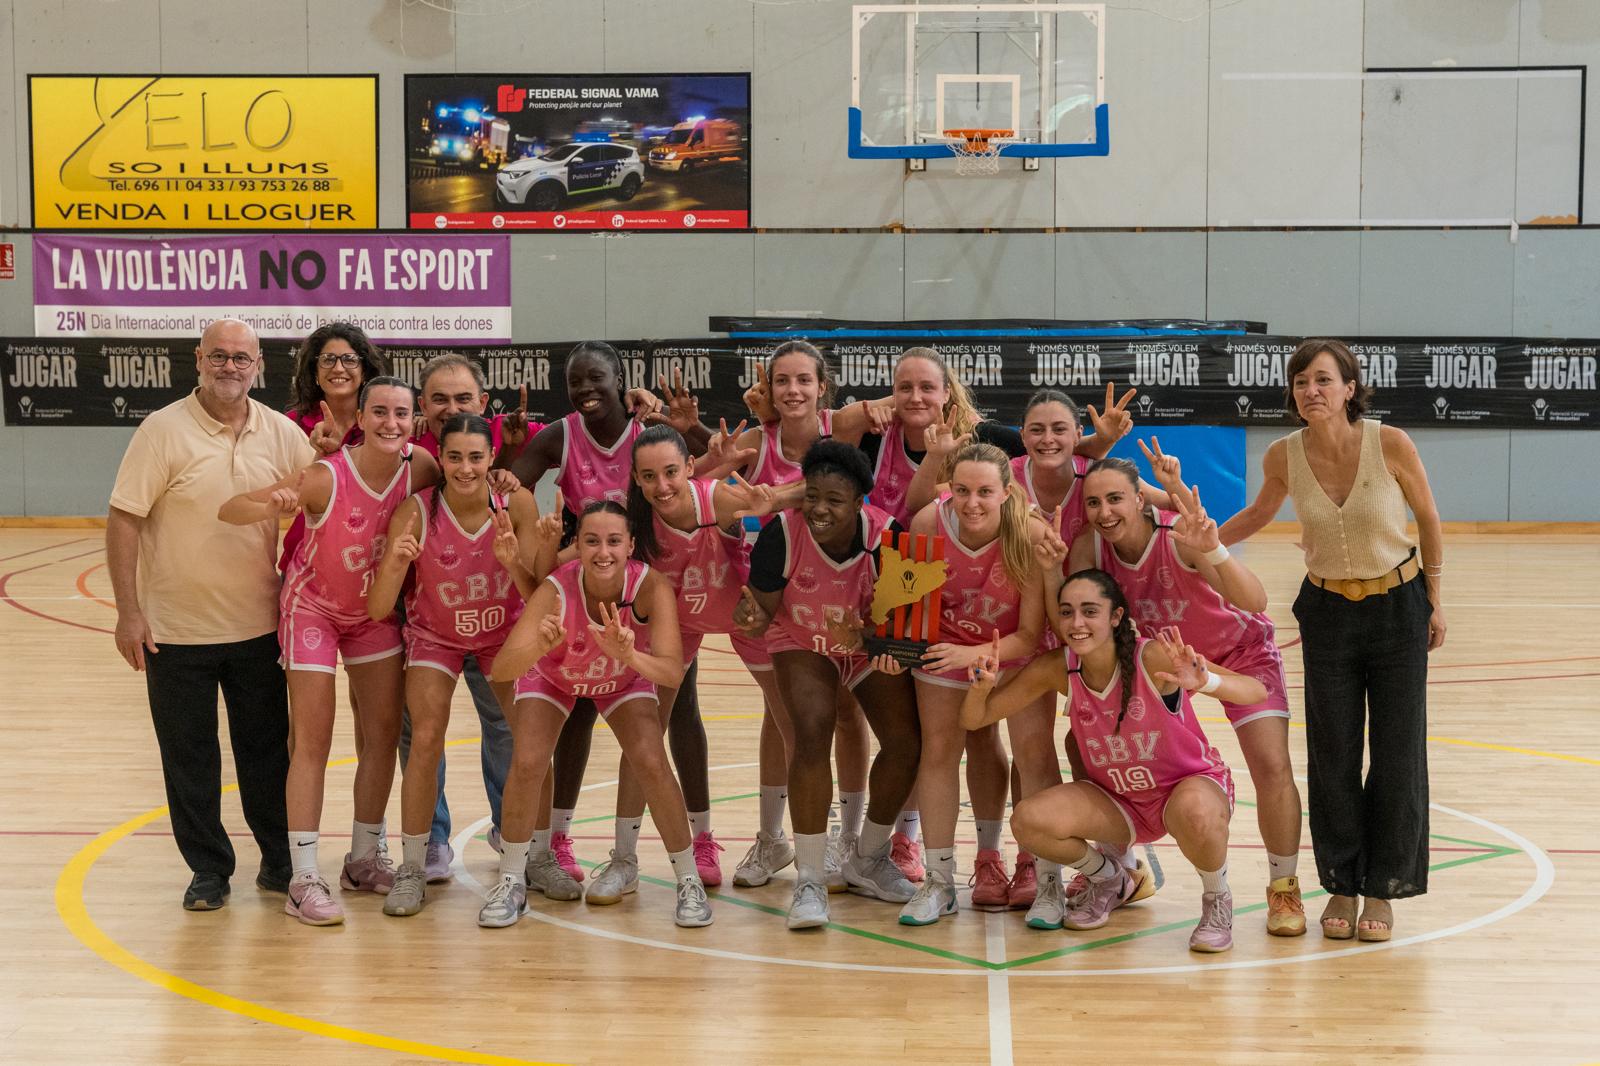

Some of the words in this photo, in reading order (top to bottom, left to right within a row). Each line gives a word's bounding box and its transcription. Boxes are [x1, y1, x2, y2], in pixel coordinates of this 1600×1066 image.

[529, 88, 579, 99] FEDERAL
[581, 87, 622, 99] SIGNAL
[625, 87, 660, 98] VAMA
[529, 101, 559, 110] Protecting
[559, 101, 580, 110] people
[580, 101, 592, 109] and
[603, 101, 623, 109] planet
[180, 162, 185, 174] I
[203, 162, 329, 174] LLUMS
[108, 179, 131, 192] Tel.
[134, 179, 160, 192] 696
[166, 179, 179, 192] 11
[186, 179, 203, 192] 04
[208, 179, 225, 192] 33
[239, 179, 256, 192] 93
[261, 179, 286, 192] 753
[291, 179, 309, 192] 26
[313, 179, 331, 192] 88
[55, 203, 166, 221] VENDA
[183, 203, 189, 221] I
[207, 203, 356, 221] LLOGUER
[52, 247, 87, 290] LA
[95, 242, 248, 291] VIOLÈNCIA
[259, 249, 327, 290] NO
[339, 248, 375, 290] FA
[384, 248, 493, 291] ESPORT
[57, 311, 86, 331] 25N
[91, 313, 111, 330] Dia
[115, 313, 195, 331] Internacional
[296, 314, 312, 329] de
[389, 317, 428, 330] contra
[432, 315, 450, 330] les
[454, 315, 493, 330] dones
[6, 343, 44, 356] #NOMÉS
[45, 346, 75, 356] VOLEM
[100, 344, 139, 357] #NOMÉS
[140, 347, 169, 356] VOLEM
[478, 348, 518, 359] #NOMÉS
[519, 349, 549, 357] VOLEM
[680, 348, 709, 356] VOLEM
[832, 344, 871, 356] #NOMÉS
[873, 346, 903, 354] VOLEM
[972, 345, 1001, 354] VOLEM
[1027, 342, 1067, 354] #NOMÉS
[1069, 344, 1100, 353] VOLEM
[1126, 342, 1166, 354] #NOMÉS
[1168, 344, 1199, 353] VOLEM
[1224, 341, 1265, 354] #NOMÉS
[1267, 344, 1297, 353] VOLEM
[1365, 345, 1396, 354] VOLEM
[1422, 344, 1463, 356] #NOMÉS
[1465, 346, 1496, 355] VOLEM
[1522, 344, 1563, 357] #NOMÉS
[1565, 347, 1596, 356] VOLEM
[9, 355, 78, 388] JUGAR
[103, 355, 172, 388] JUGAR
[483, 357, 551, 390] JUGAR
[1030, 353, 1101, 387] JUGAR
[1129, 353, 1200, 387] JUGAR
[1425, 355, 1497, 389] JUGAR
[1524, 356, 1597, 390] JUGAR
[684, 593, 708, 615] 7
[455, 605, 505, 637] 50
[1107, 765, 1157, 794] 19
